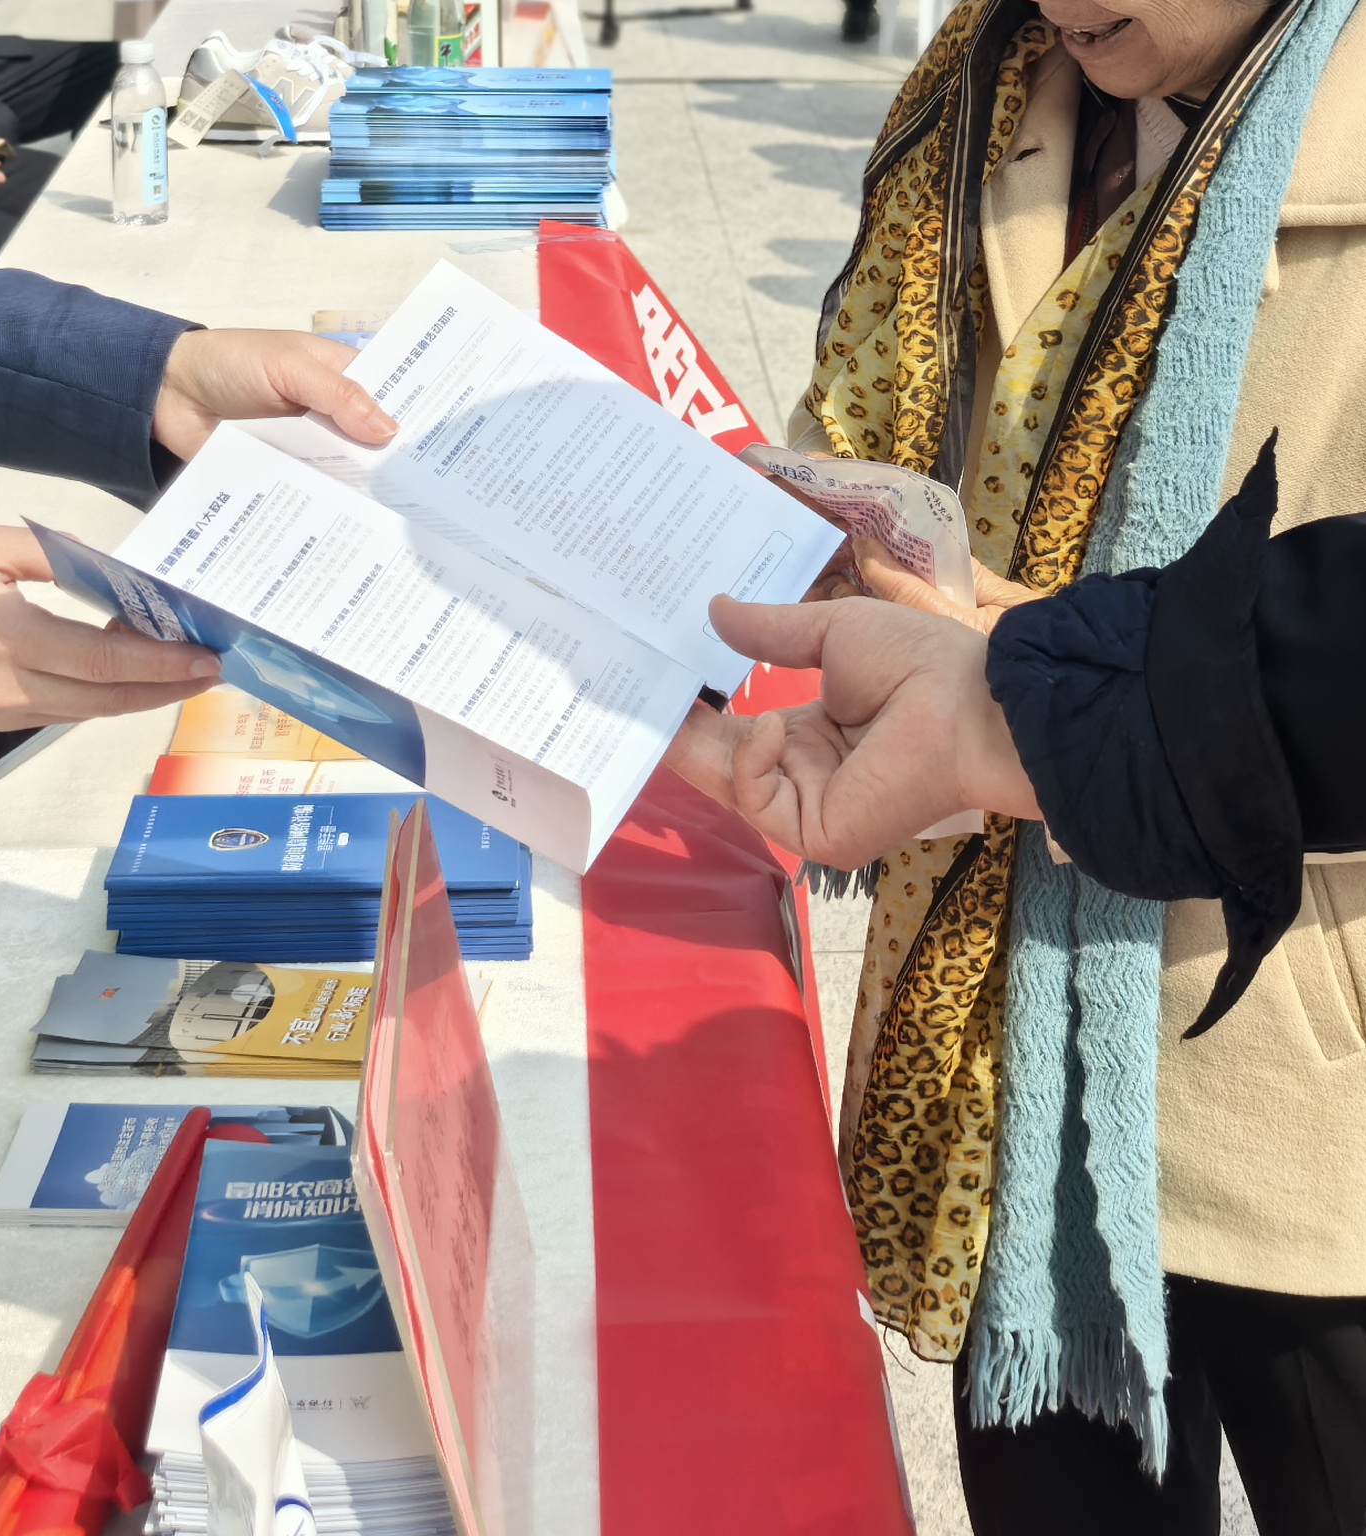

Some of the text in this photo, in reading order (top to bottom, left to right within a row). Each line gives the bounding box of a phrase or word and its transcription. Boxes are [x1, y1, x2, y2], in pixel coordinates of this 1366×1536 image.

[155, 488, 231, 576] 金融消费者八大权益
